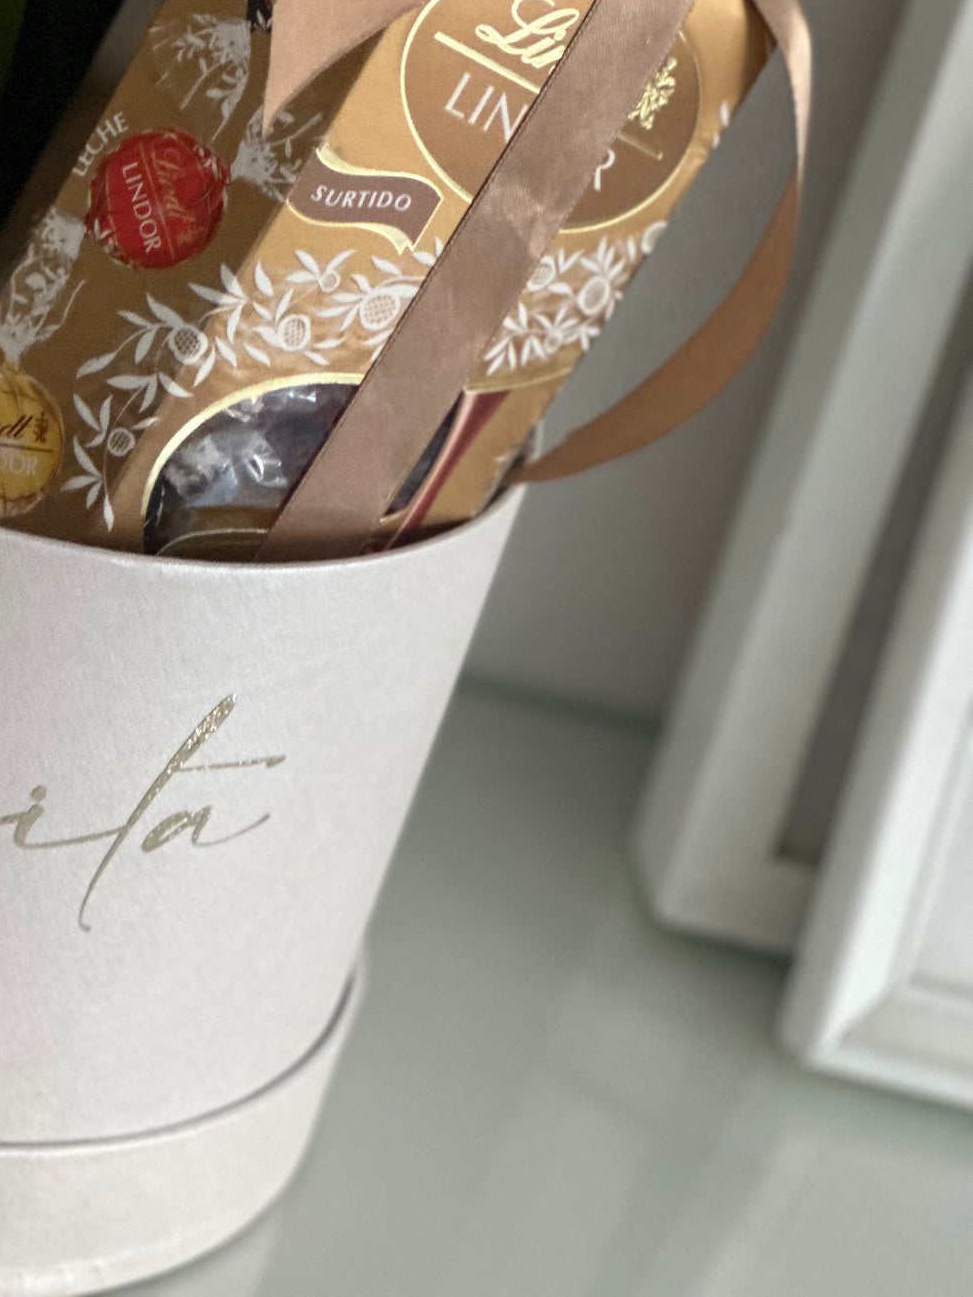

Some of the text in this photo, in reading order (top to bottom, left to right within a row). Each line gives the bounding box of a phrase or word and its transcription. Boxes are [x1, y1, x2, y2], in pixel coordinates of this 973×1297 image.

[71, 111, 129, 177] LECHE
[122, 161, 163, 254] LINDOR
[310, 183, 413, 212] SURTIDO
